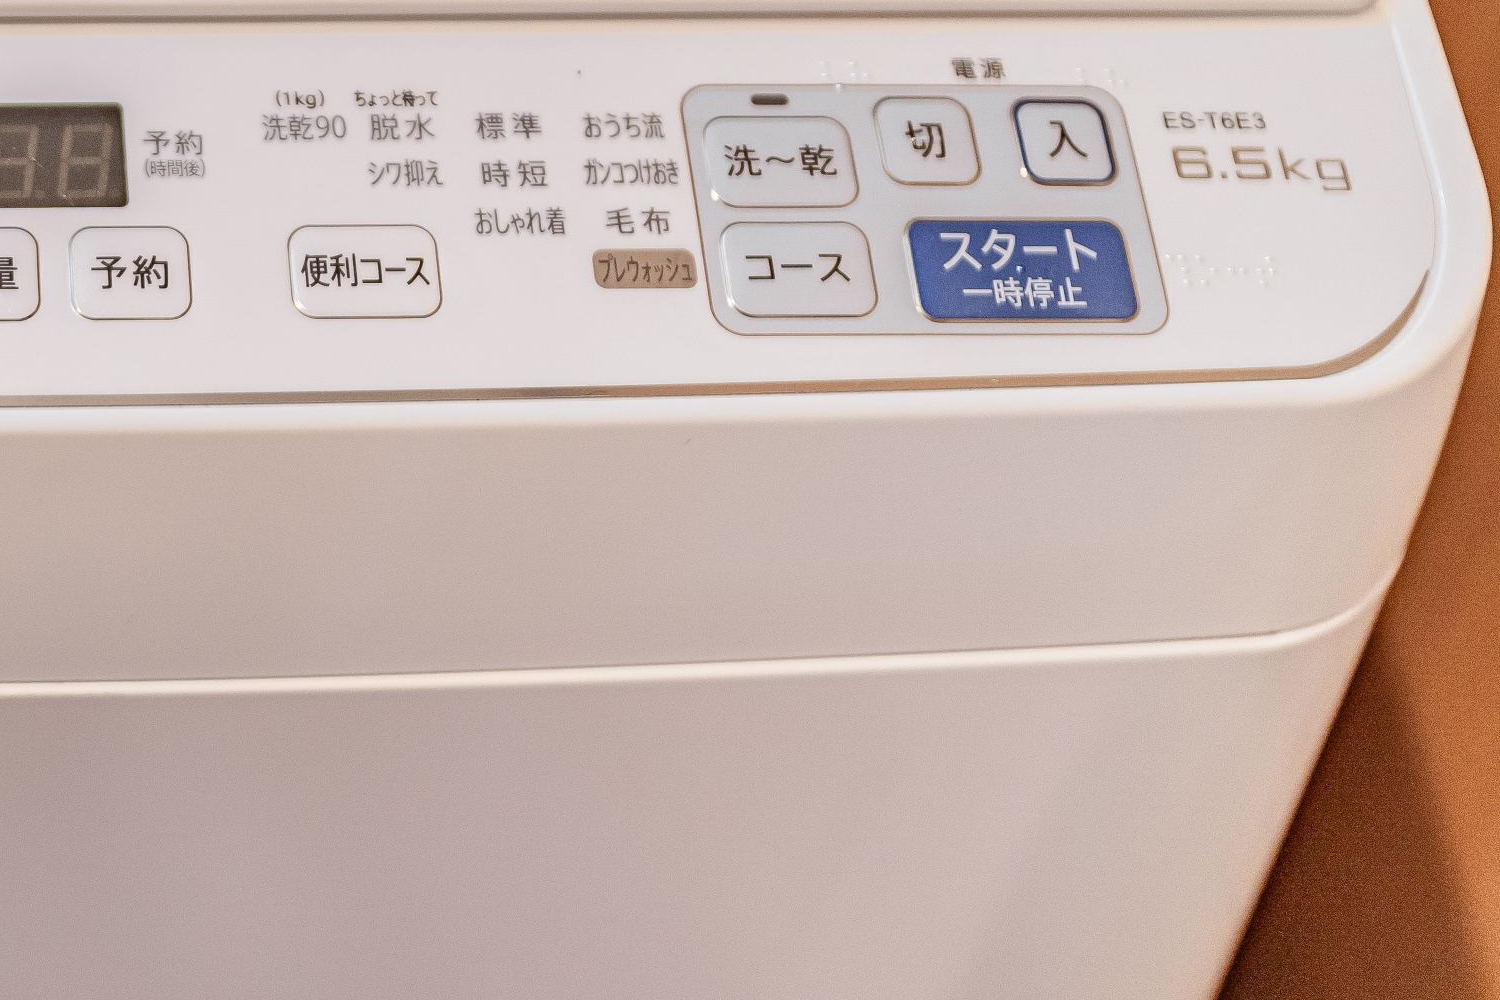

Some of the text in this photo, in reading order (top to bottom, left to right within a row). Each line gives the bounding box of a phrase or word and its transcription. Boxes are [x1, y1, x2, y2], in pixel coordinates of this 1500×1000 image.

[951, 58, 1006, 80] 電源
[275, 90, 325, 110] (1kg)
[353, 89, 438, 108] ちょっと待って
[261, 113, 347, 142] 洗乾90
[370, 112, 435, 142] 脱水
[474, 112, 542, 140] 標準
[582, 112, 666, 139] おうち流
[1162, 111, 1267, 131] ES-T6E3
[142, 129, 203, 156] 予約
[905, 121, 947, 159] 切
[1049, 120, 1089, 159] 入
[144, 158, 206, 178] (時間後)
[367, 158, 444, 187] シワ抑え
[480, 159, 549, 188] 時短
[583, 158, 679, 186] ガンコつけおき
[474, 206, 566, 236] おしゃれ着
[605, 206, 670, 235] 毛布
[938, 228, 1098, 272] スタート
[90, 254, 169, 290] 予約
[300, 252, 431, 288] 便利コース
[745, 253, 851, 283] コース
[962, 277, 1088, 309] 一時停止
